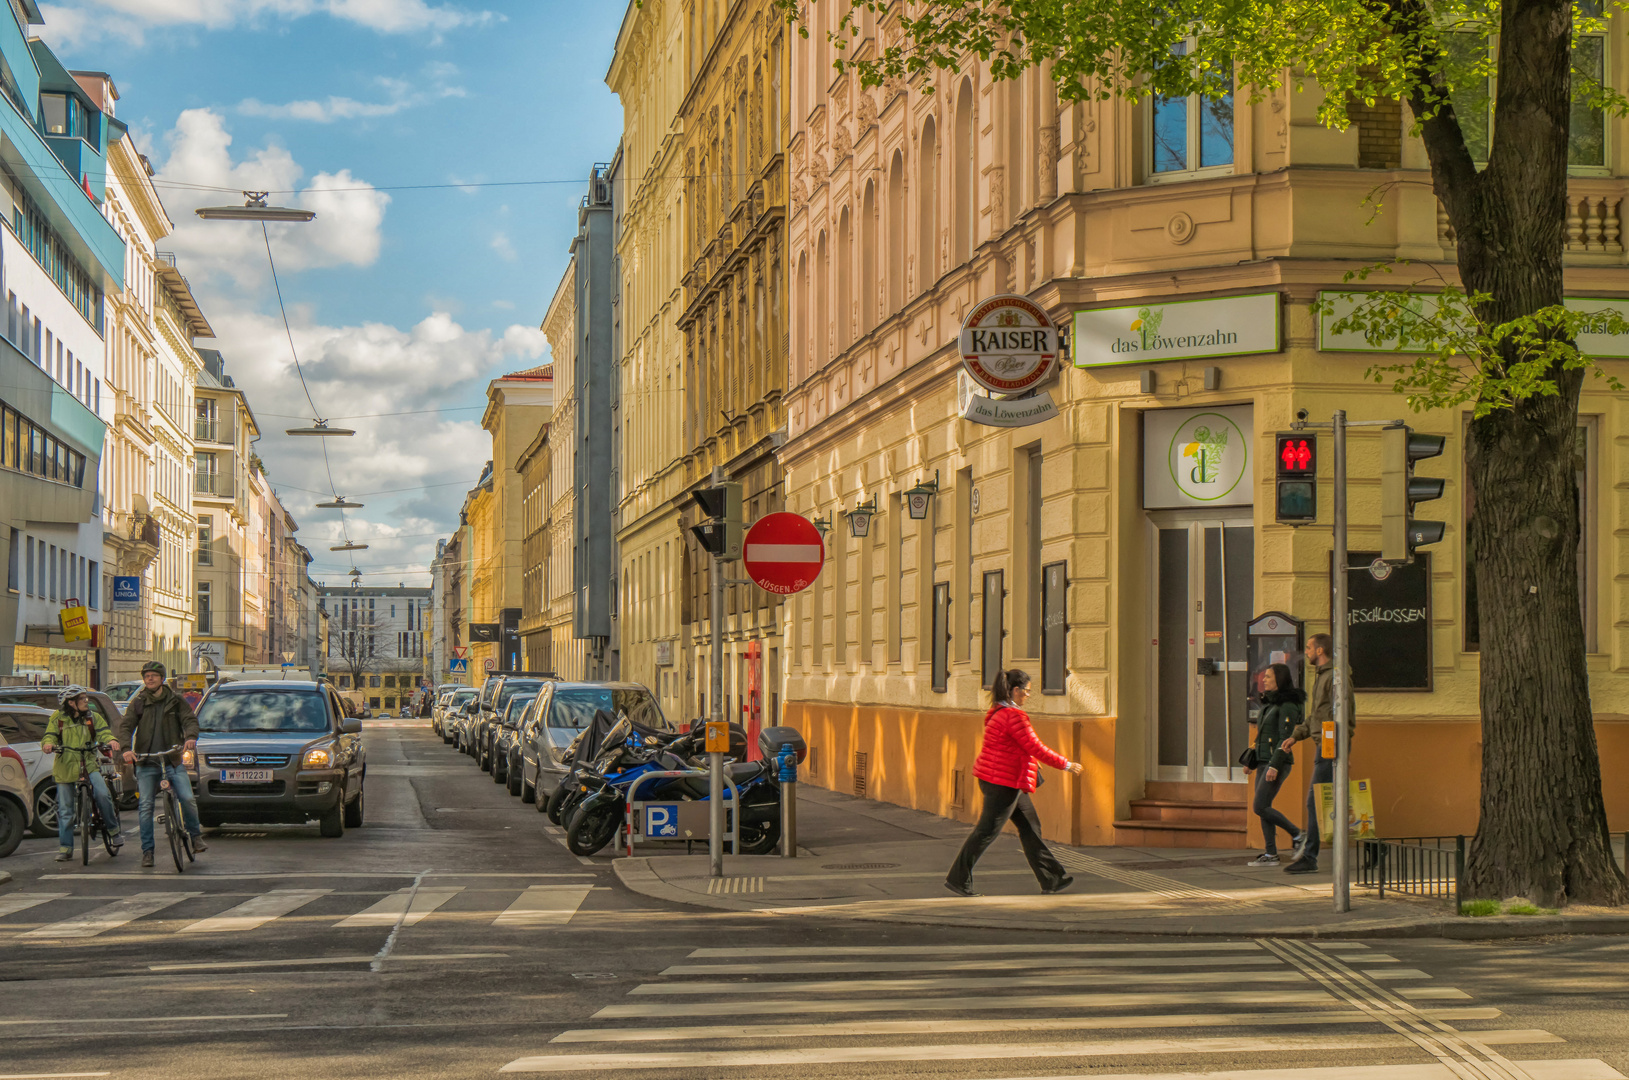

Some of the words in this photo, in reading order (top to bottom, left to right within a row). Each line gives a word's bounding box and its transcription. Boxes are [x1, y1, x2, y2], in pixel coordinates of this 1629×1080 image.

[971, 330, 1048, 352] KAISER
[1110, 337, 1139, 354] das
[1142, 328, 1238, 351] Löwenzahn
[995, 356, 1027, 374] Bier
[975, 404, 993, 417] das
[994, 403, 1052, 419] Löwenzahn
[66, 617, 84, 627] BILLA
[229, 771, 236, 779] W
[647, 807, 670, 835] P
